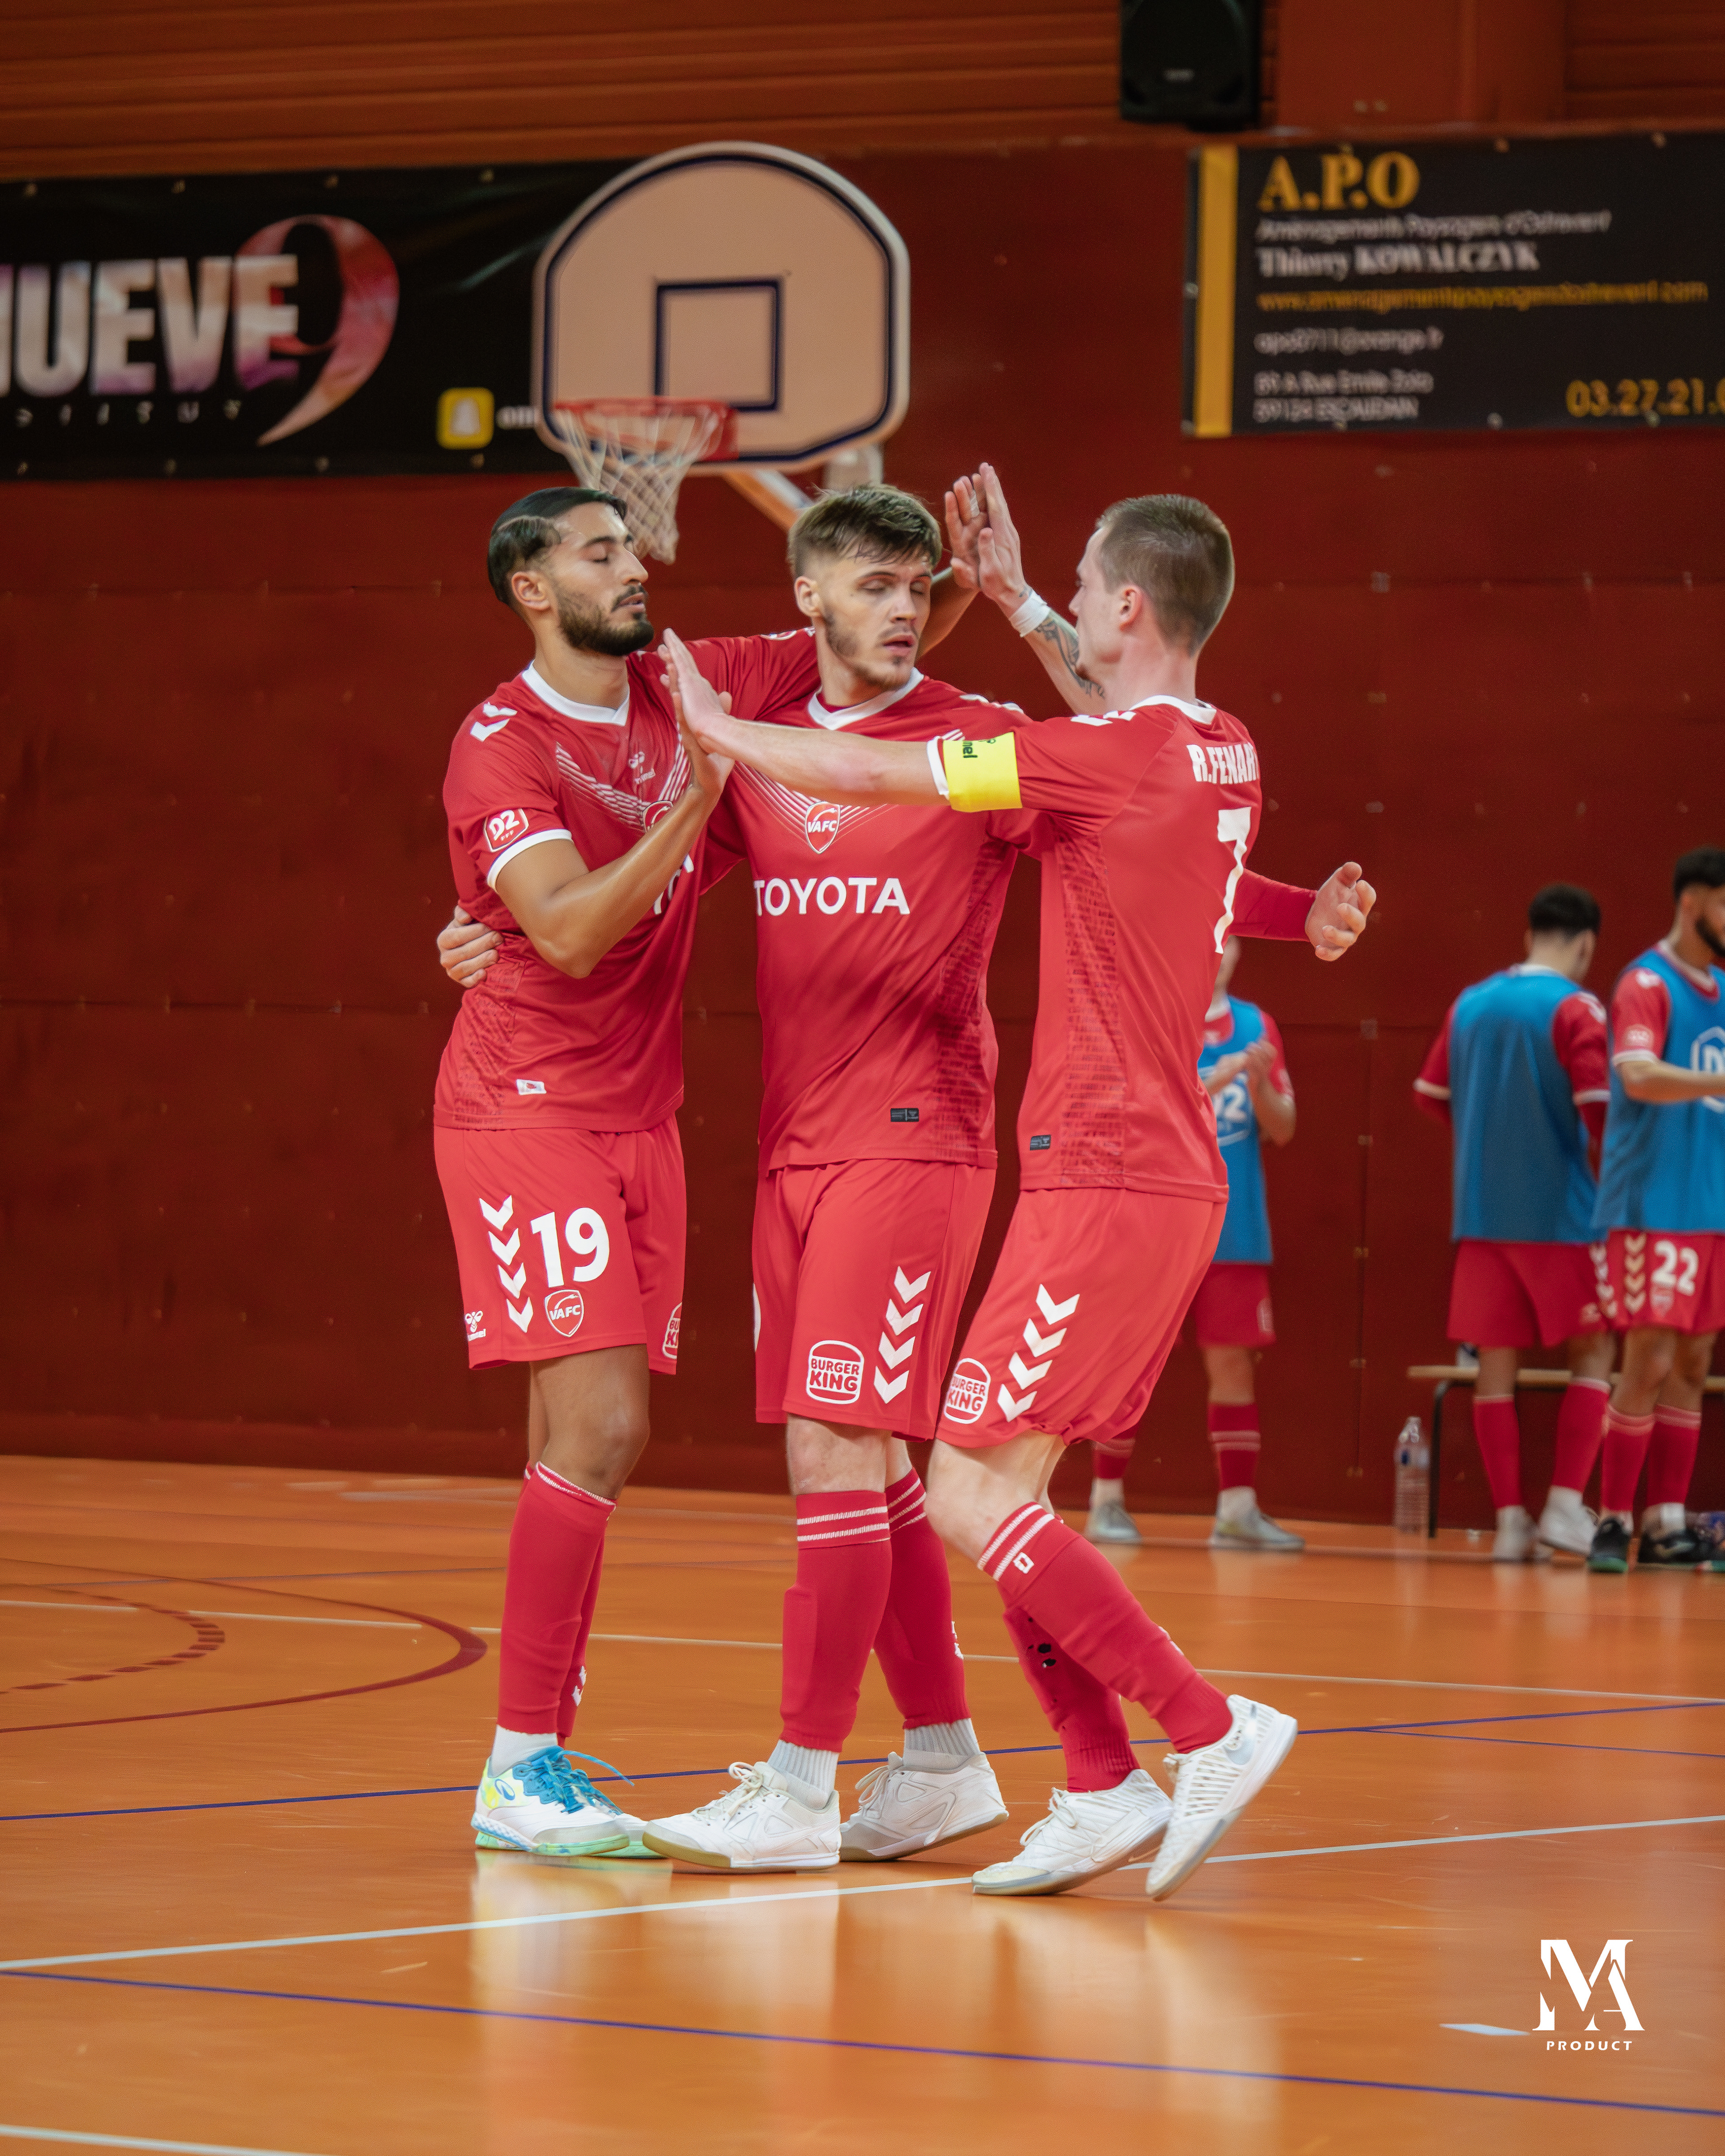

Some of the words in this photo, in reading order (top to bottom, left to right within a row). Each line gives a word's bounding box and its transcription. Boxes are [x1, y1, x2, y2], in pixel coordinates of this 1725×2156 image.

[1257, 150, 1421, 212] A.P.O
[0, 254, 298, 397] UEVE
[488, 809, 521, 841] D2
[808, 820, 837, 833] VAFC
[753, 876, 911, 917] TOYOTA
[1214, 806, 1252, 954] 7
[530, 1207, 610, 1288] 19
[1650, 1240, 1699, 1296] 22
[548, 1303, 581, 1321] VAFC
[809, 1370, 858, 1392] KING
[810, 1358, 860, 1376] BURGER
[947, 1389, 984, 1412] KING
